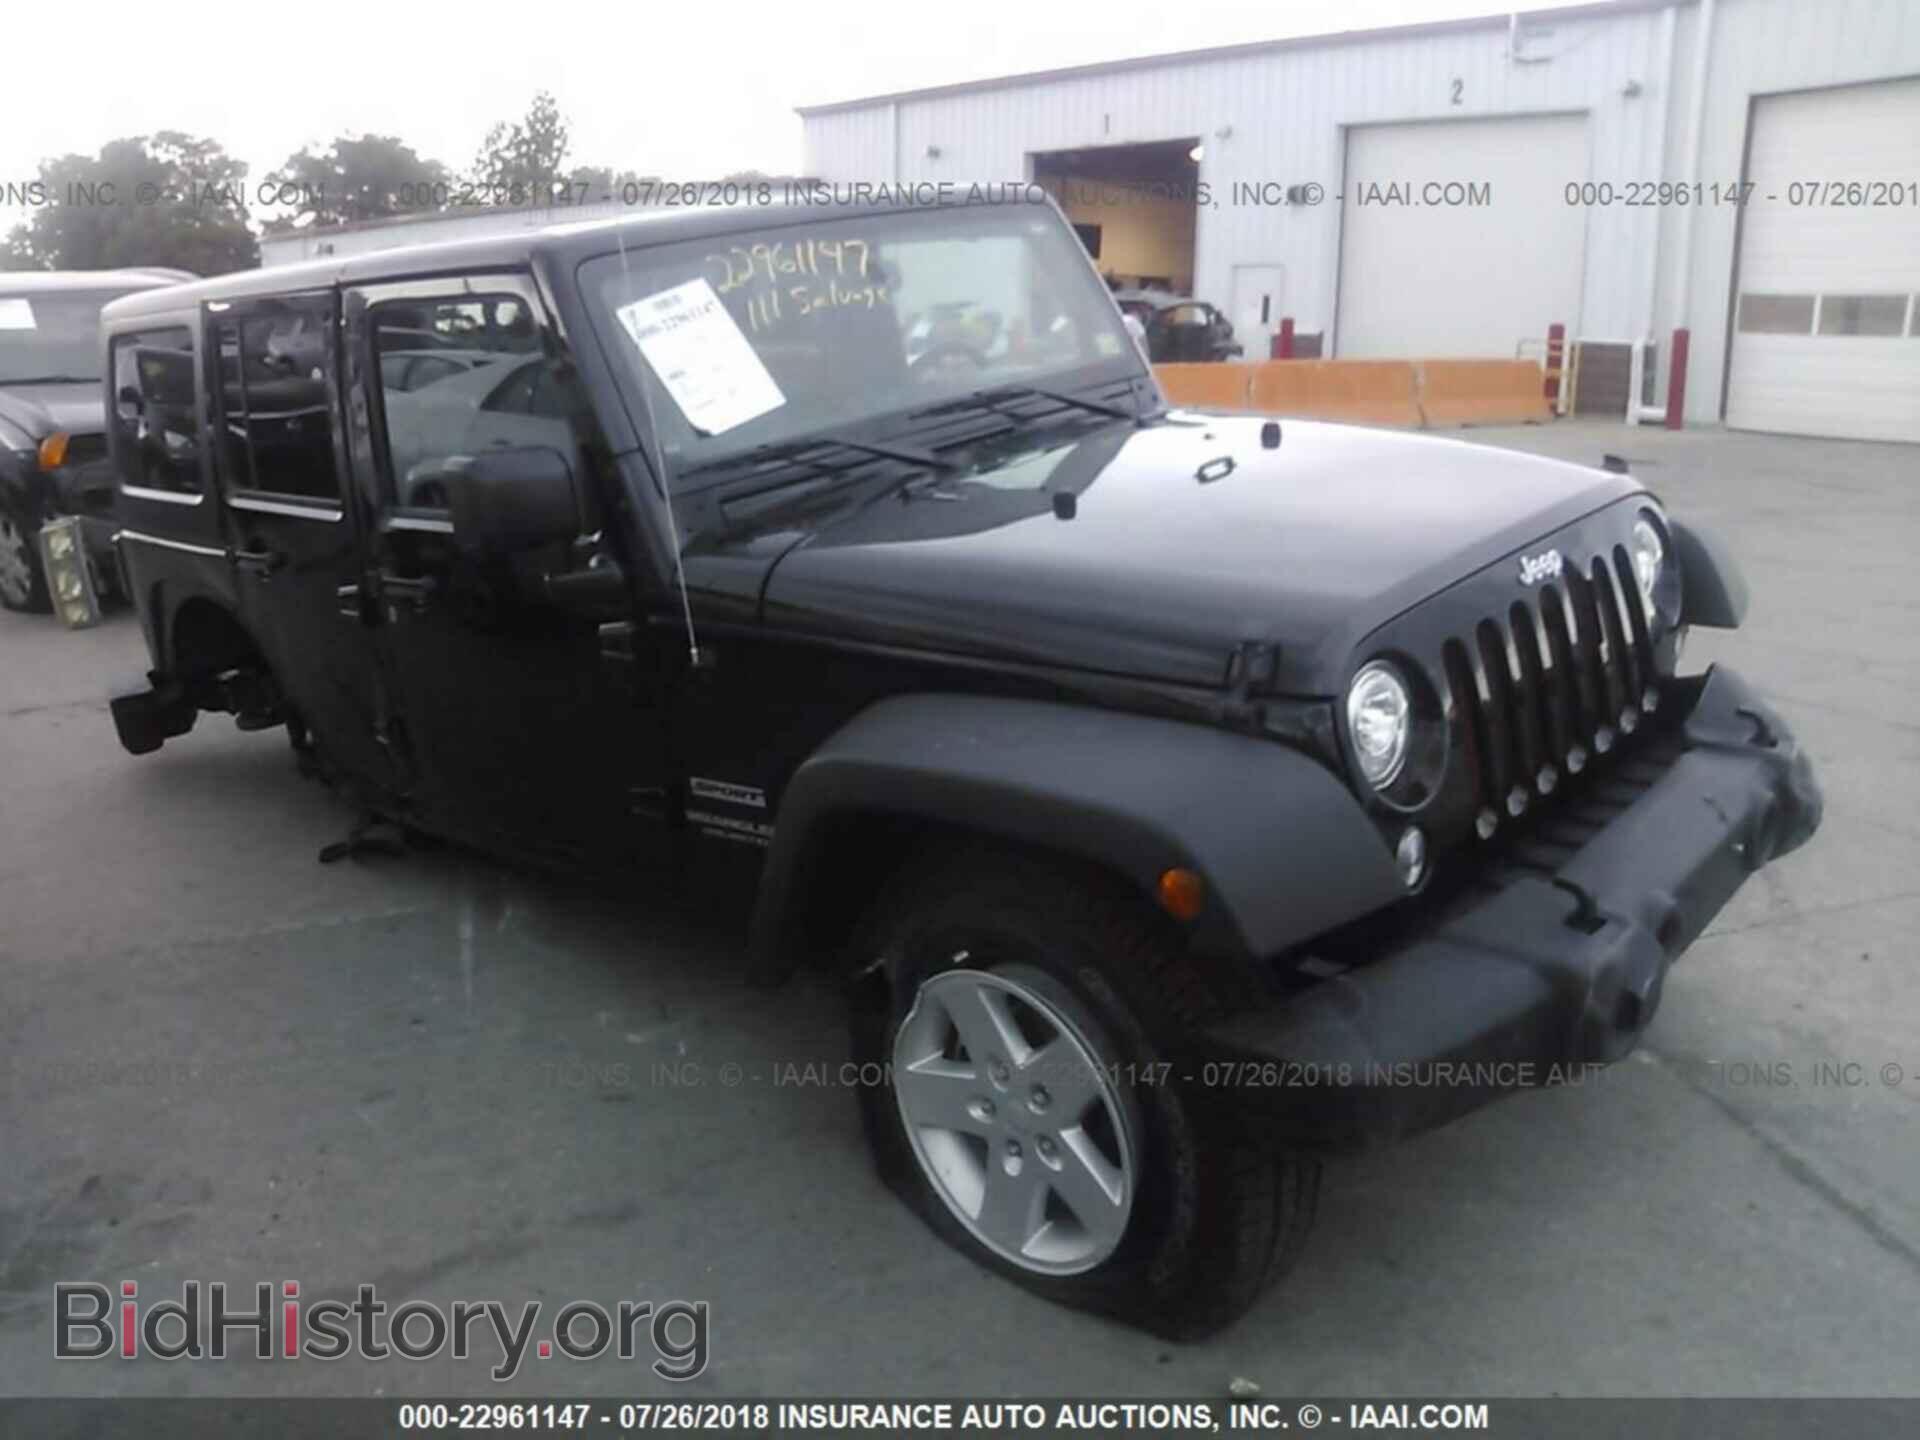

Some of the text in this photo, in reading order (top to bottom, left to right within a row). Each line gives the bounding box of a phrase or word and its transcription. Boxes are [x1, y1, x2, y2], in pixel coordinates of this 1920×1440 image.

[1450, 77, 1464, 106] 2
[704, 239, 869, 295] 22961147
[1519, 549, 1563, 585] Jeep
